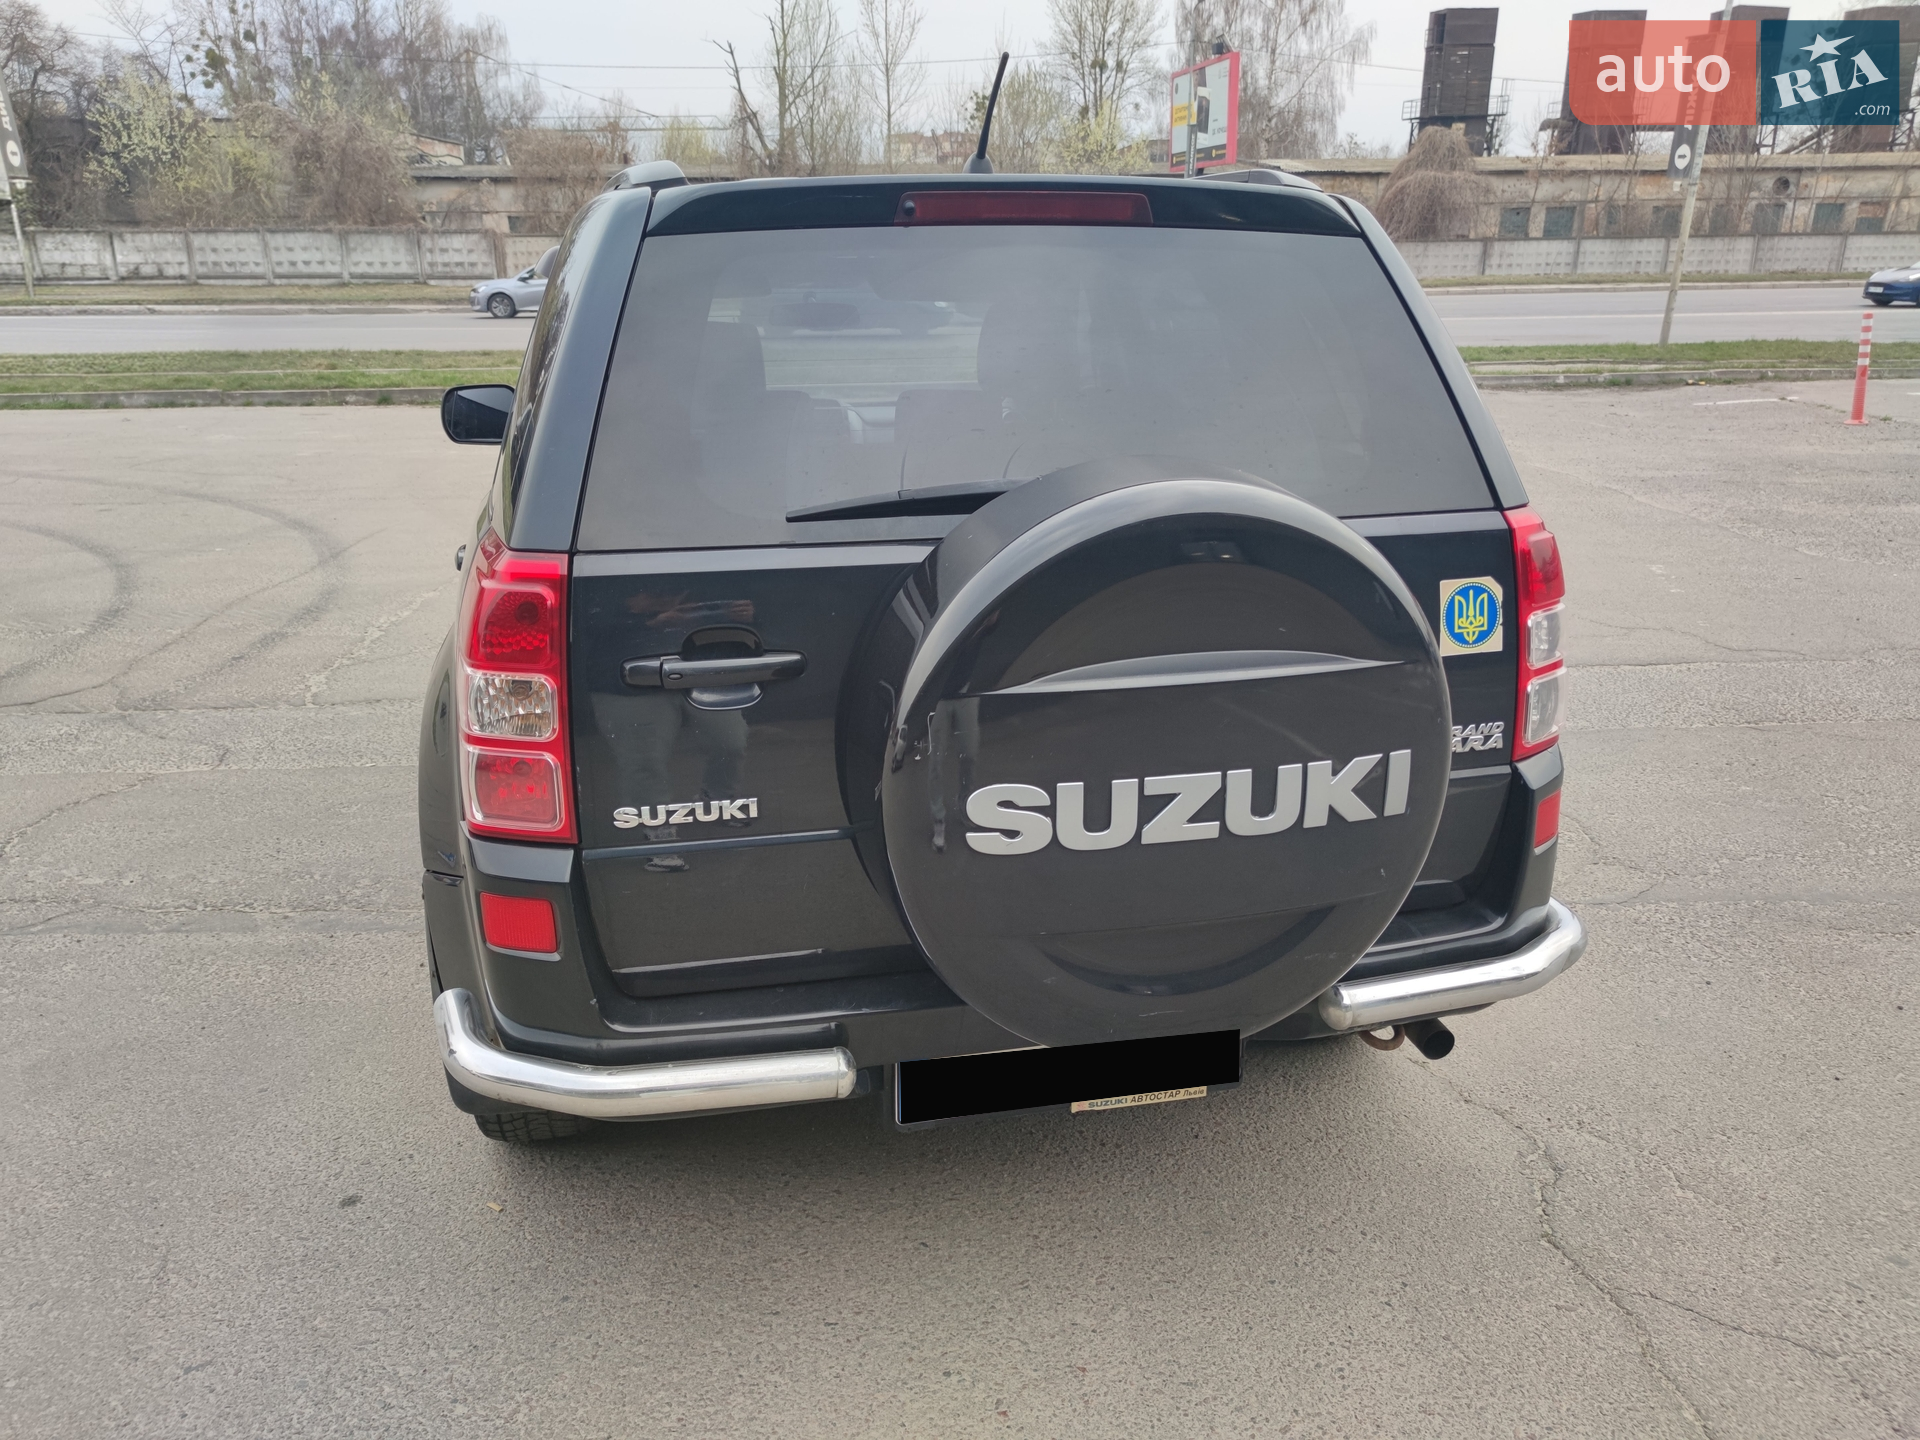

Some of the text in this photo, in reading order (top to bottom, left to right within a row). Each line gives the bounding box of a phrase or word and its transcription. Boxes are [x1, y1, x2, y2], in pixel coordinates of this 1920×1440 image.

[1452, 722, 1504, 737] RAND
[1452, 733, 1503, 753] ARA
[965, 749, 1411, 855] SUZUKI
[613, 797, 758, 829] SUZUKI
[1088, 1088, 1205, 1108] SUZUKI АВТОСТАР Львів
